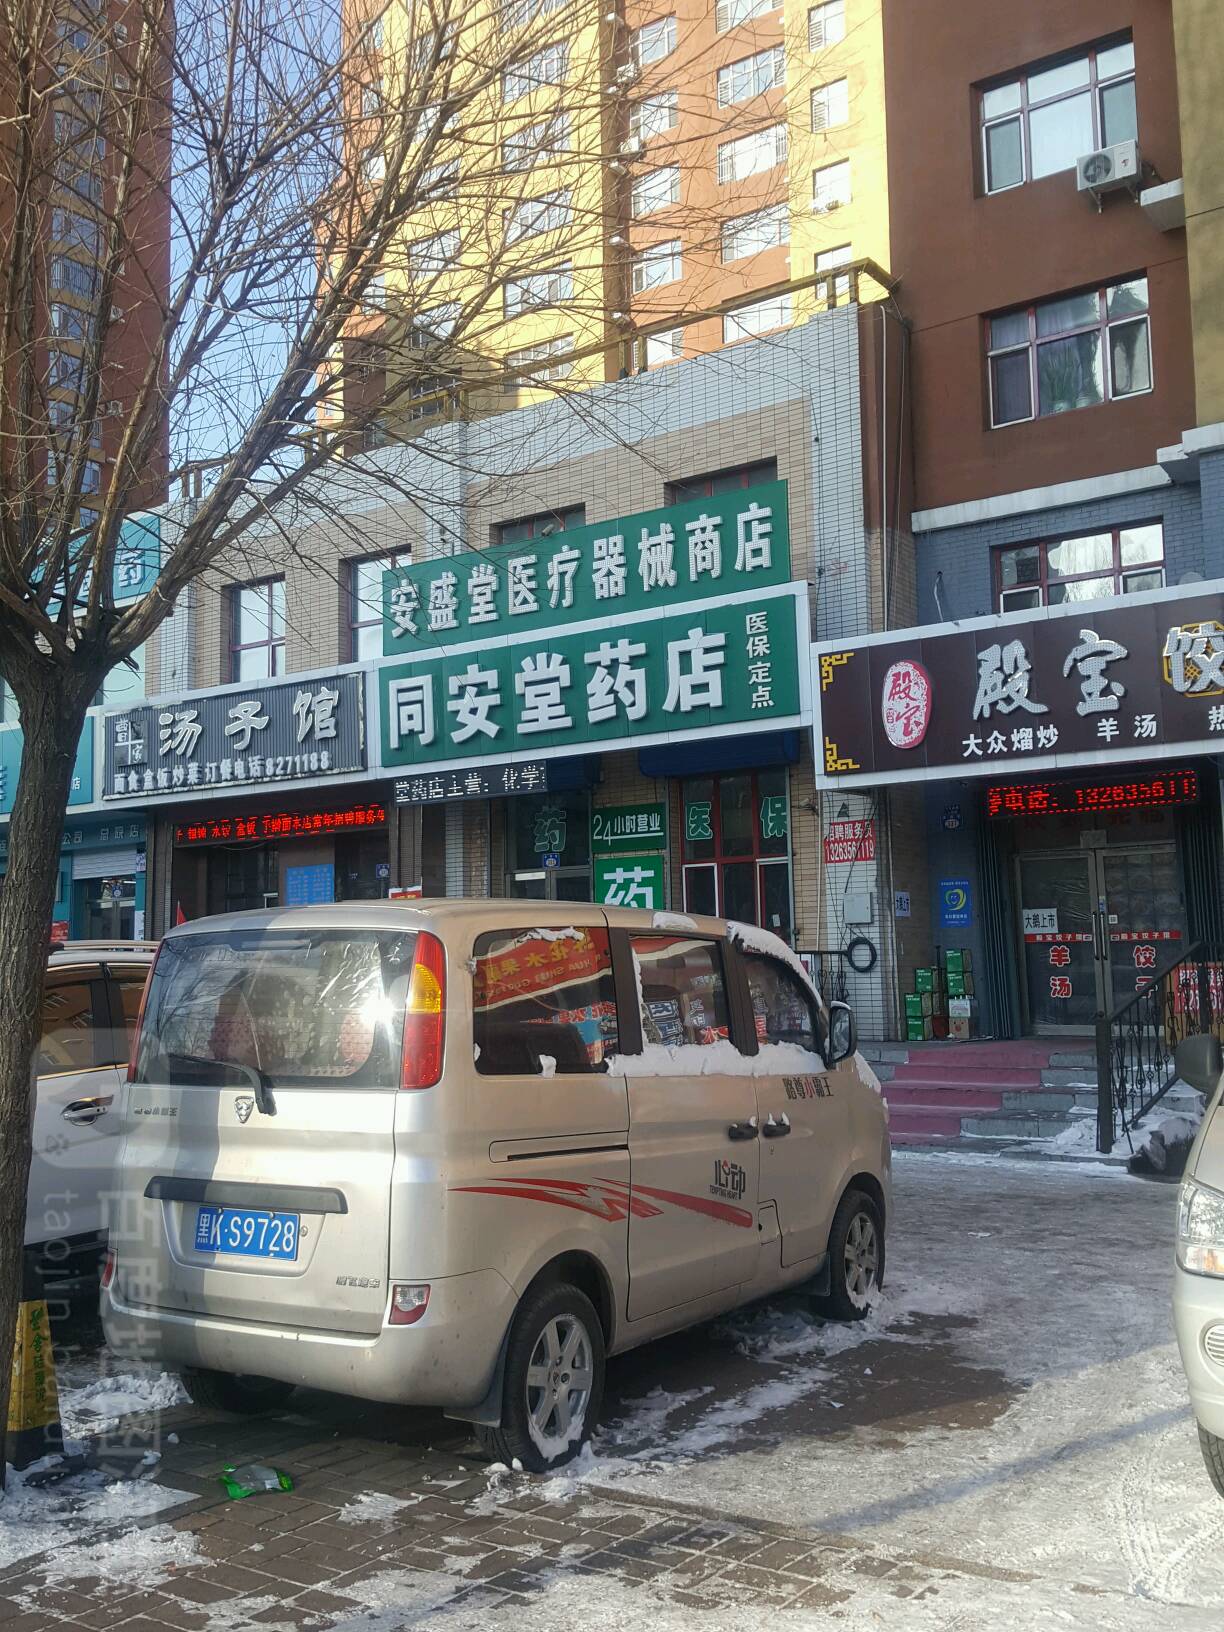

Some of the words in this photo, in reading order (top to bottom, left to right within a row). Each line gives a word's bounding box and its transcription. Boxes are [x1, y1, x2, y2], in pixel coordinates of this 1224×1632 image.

[391, 502, 773, 638] 安盛堂医疗器械商店
[745, 611, 775, 709] 医保定点
[388, 627, 726, 750] 同安堂药店
[158, 686, 340, 758] 汤子馆
[962, 725, 1059, 758] 大众熘炒
[1097, 714, 1158, 742] 羊汤
[502, 765, 545, 791] 化学
[593, 812, 664, 846] 24小时营业
[604, 866, 654, 909] 药
[1025, 913, 1055, 930] 大鹅上市
[1049, 944, 1073, 998] 羊汤
